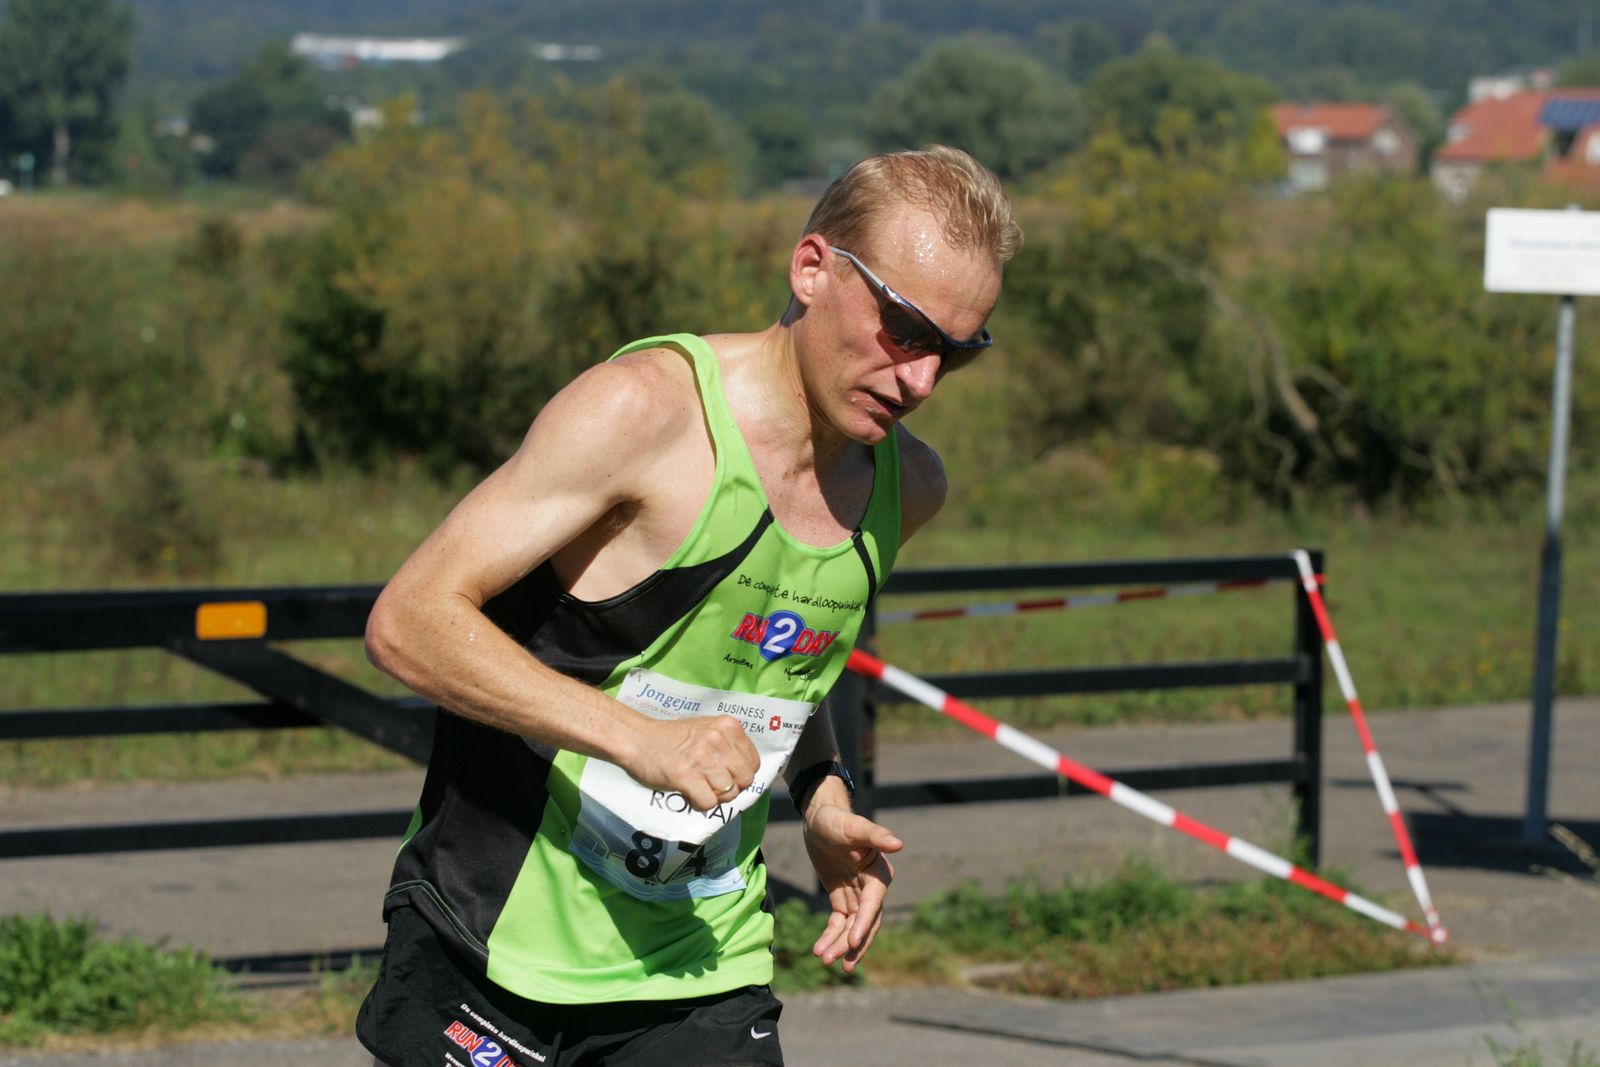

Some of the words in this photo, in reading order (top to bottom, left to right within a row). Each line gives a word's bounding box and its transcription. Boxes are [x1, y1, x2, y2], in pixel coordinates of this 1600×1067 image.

[737, 574, 752, 587] De
[636, 683, 701, 712] Jongejan
[717, 702, 765, 719] BUSINESS
[749, 722, 765, 734] EM
